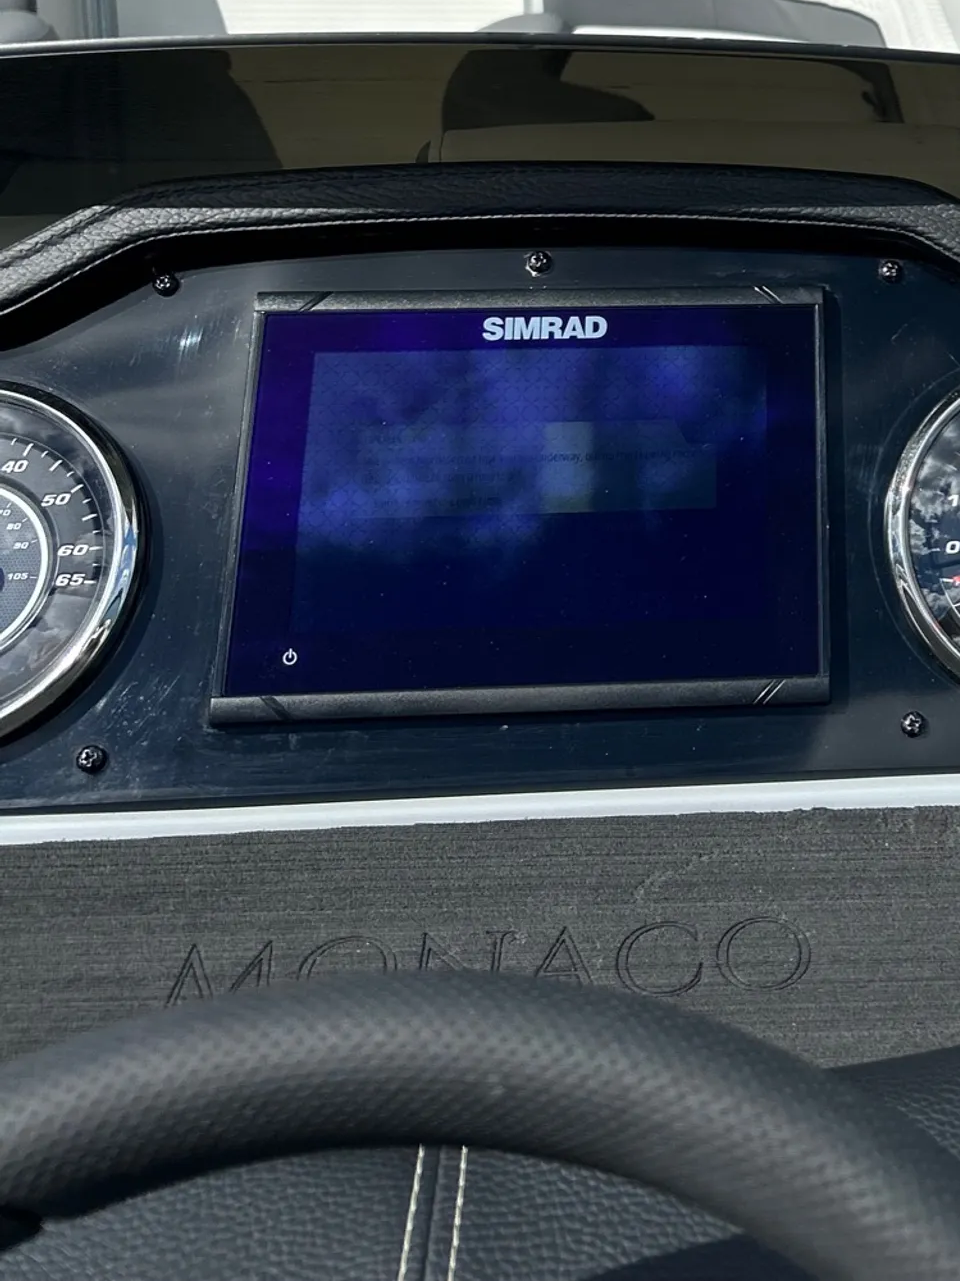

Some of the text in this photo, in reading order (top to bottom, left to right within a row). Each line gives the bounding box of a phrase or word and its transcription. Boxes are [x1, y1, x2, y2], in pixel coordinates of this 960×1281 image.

[482, 316, 608, 341] SIMRAD
[0, 460, 28, 473] 40
[41, 493, 71, 507] 50
[948, 494, 959, 507] 1
[57, 544, 89, 556] 60
[7, 572, 29, 580] 105
[55, 573, 85, 586] 65
